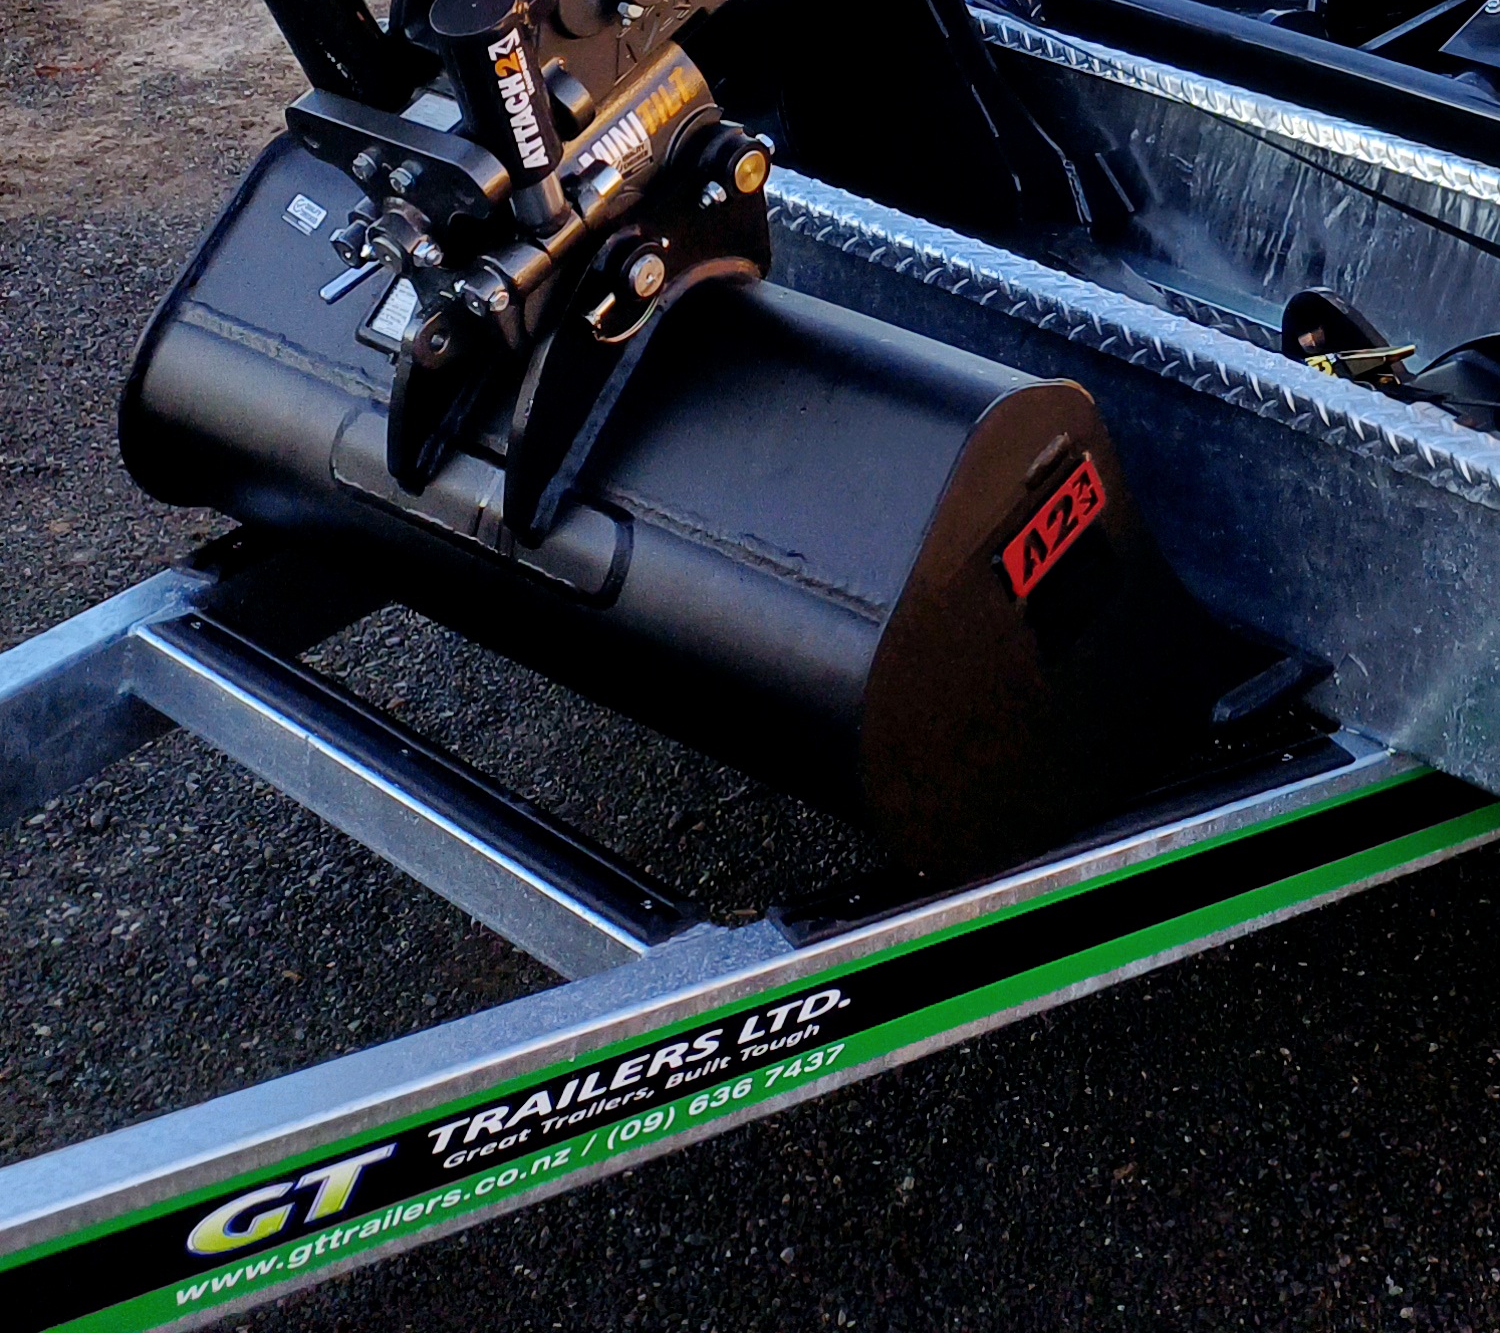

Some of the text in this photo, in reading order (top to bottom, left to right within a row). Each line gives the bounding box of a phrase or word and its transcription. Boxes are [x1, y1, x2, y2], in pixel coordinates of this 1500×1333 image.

[428, 989, 851, 1155] TRAILERS LTD.
[443, 1023, 820, 1169] Great Trailers, Built Tough
[176, 1147, 572, 1307] www.gttrailers.co.nz
[607, 1106, 676, 1150] (09)
[689, 1077, 753, 1116] 636
[764, 1043, 845, 1088] 7437
[186, 1142, 397, 1255] GT
